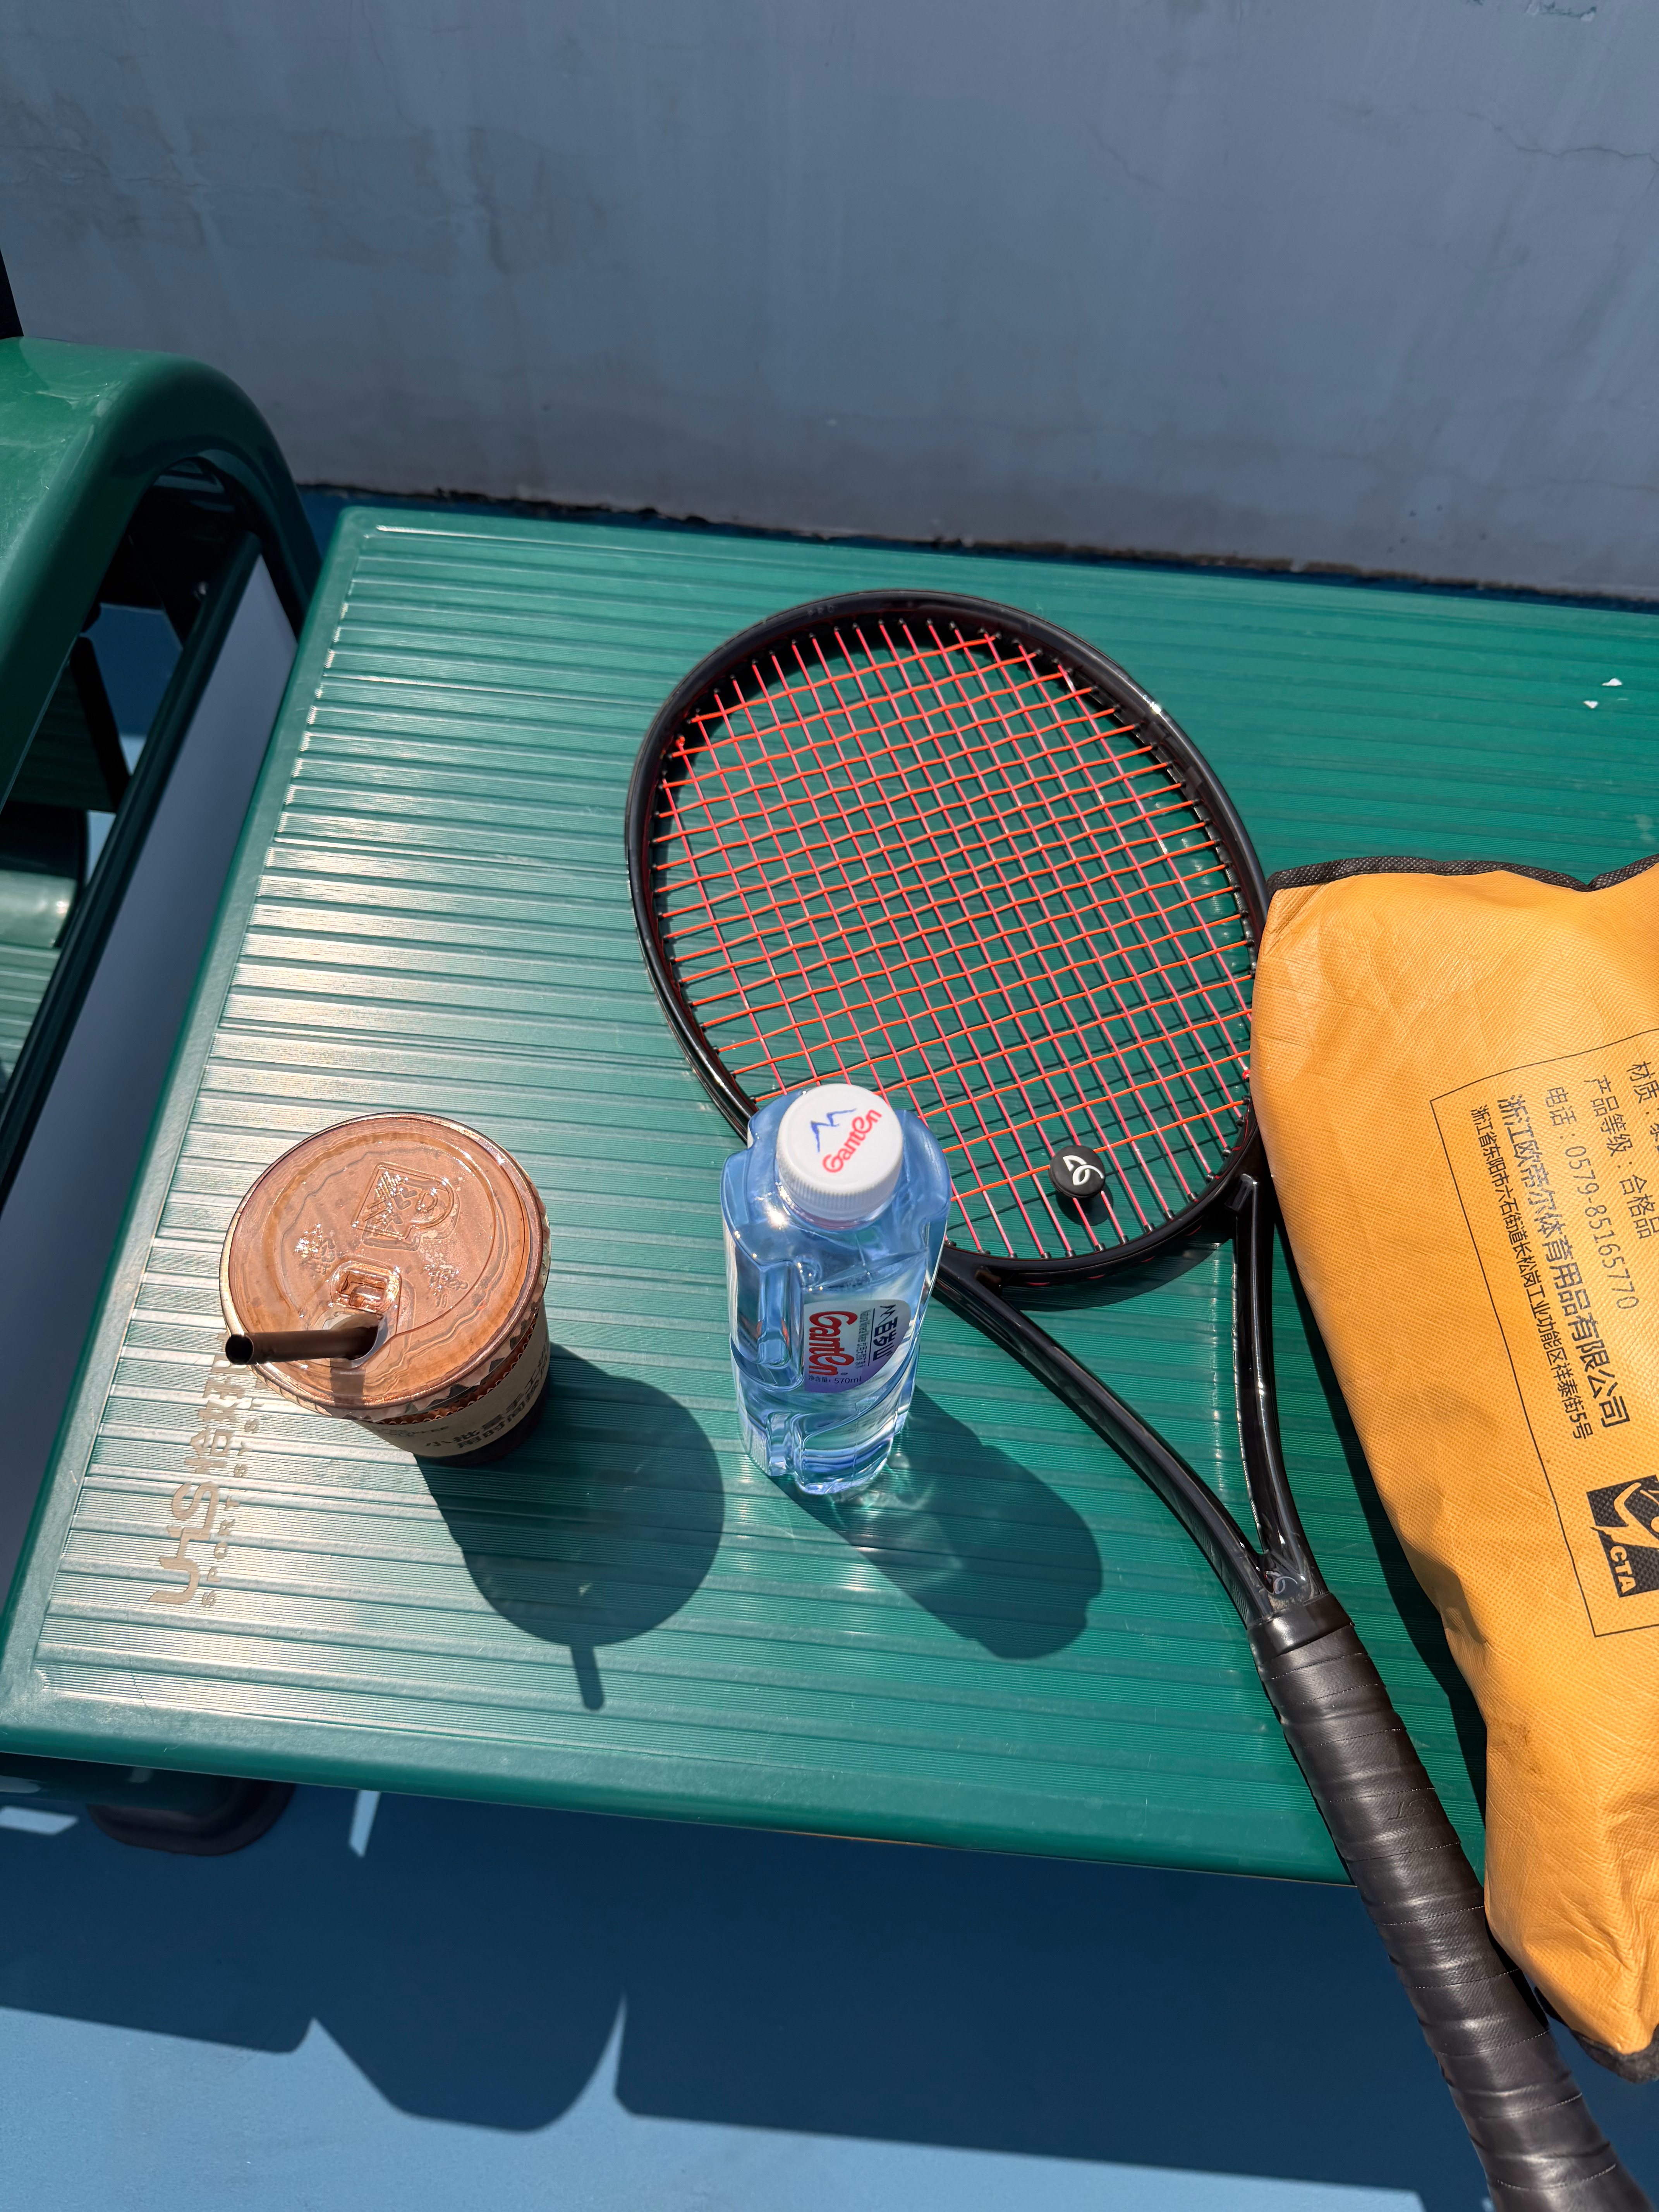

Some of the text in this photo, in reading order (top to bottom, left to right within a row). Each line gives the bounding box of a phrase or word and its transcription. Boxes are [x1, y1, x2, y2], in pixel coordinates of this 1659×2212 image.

[822, 1109, 883, 1173] Ganten
[1497, 1093, 1630, 1427] 浙江欧帝尔体育用品有限公司
[809, 1311, 858, 1376] Ganten
[873, 1316, 898, 1361] 百岁山
[1610, 1546, 1636, 1594] CTA
